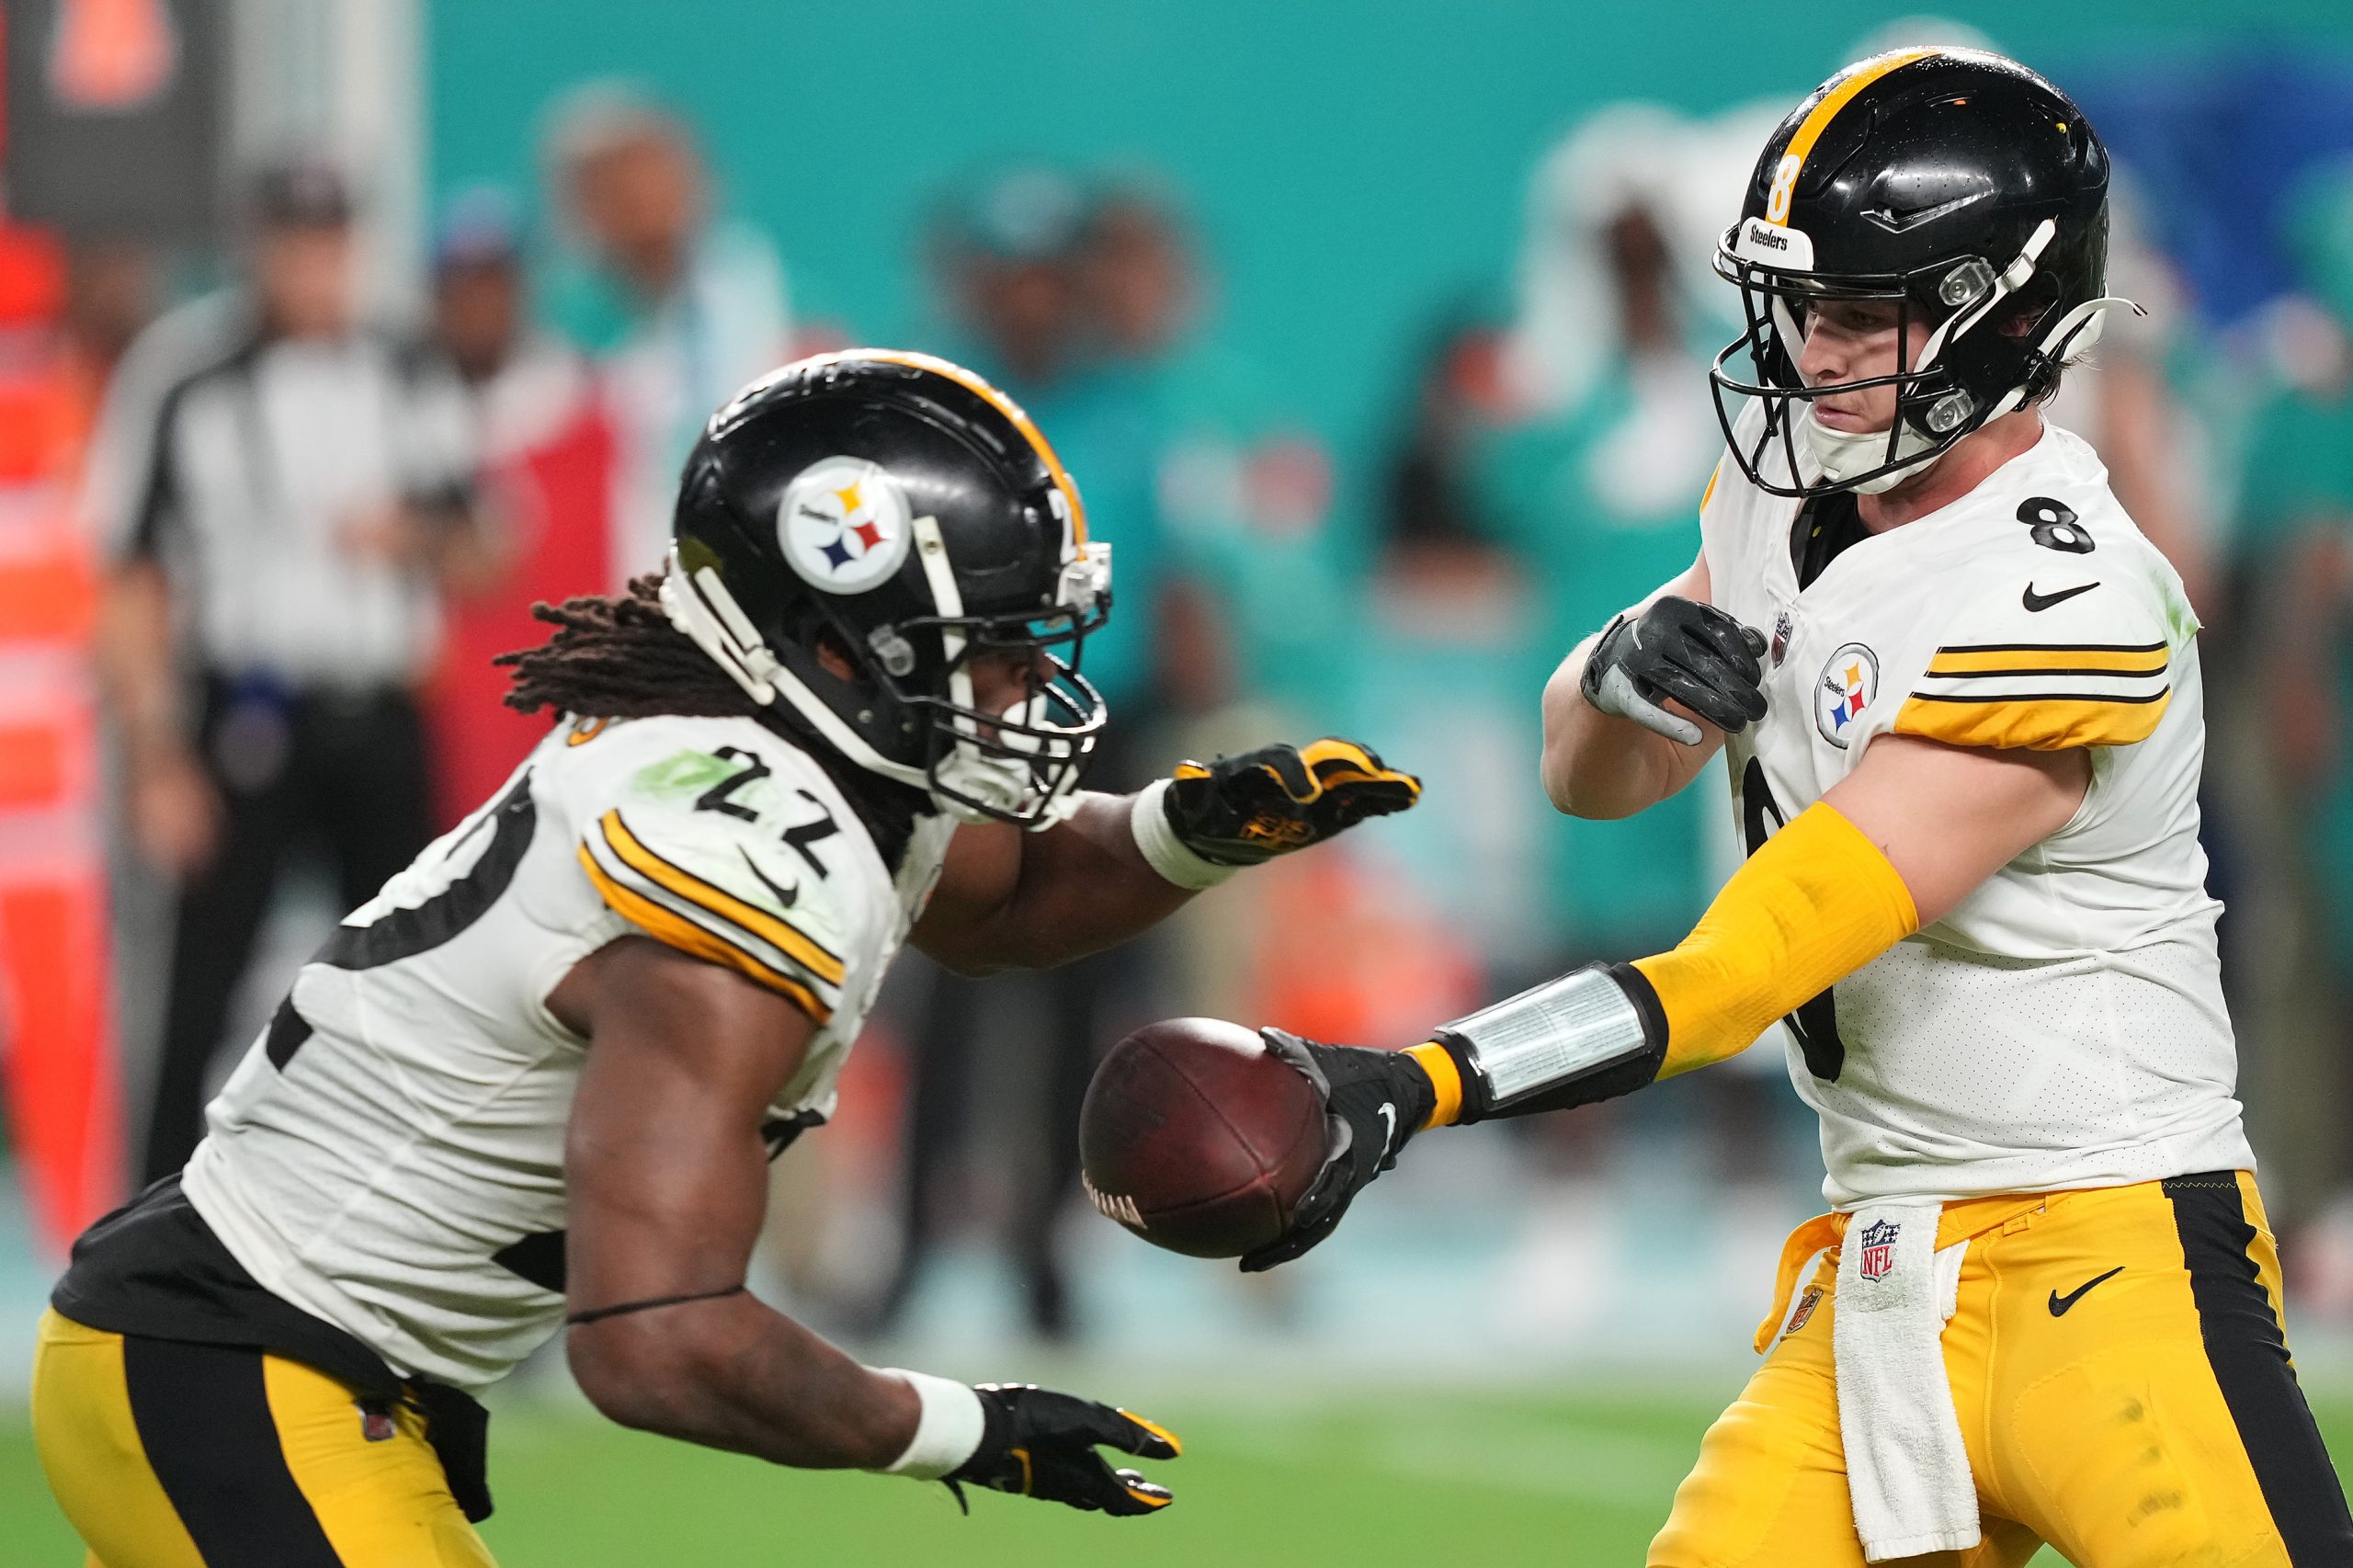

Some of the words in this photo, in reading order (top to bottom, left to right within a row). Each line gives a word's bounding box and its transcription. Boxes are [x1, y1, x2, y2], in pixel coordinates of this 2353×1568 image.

[1768, 154, 1801, 222] 8
[1750, 224, 1788, 251] Steelers
[2016, 496, 2096, 554] 8
[694, 745, 841, 880] 22
[1862, 1245, 1893, 1277] NFL
